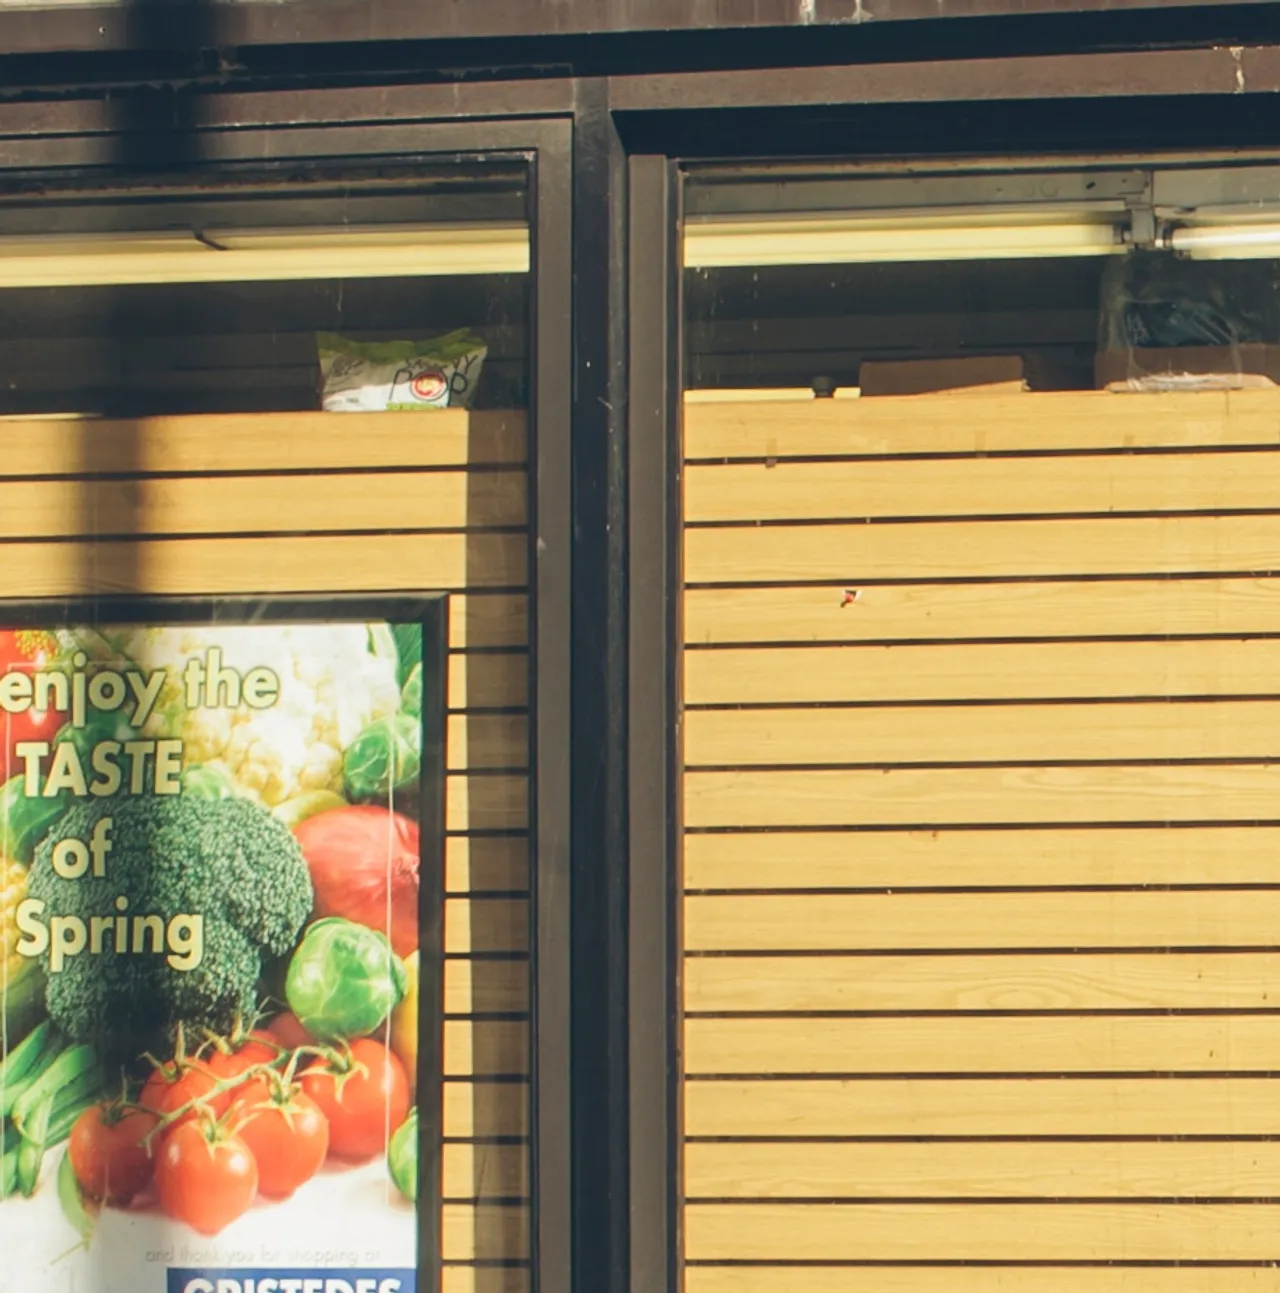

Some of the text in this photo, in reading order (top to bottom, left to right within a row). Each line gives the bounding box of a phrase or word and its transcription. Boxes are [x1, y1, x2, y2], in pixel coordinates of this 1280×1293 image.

[0, 647, 279, 727] enjoy the
[15, 740, 184, 797] TASTE
[52, 818, 113, 879] of
[15, 895, 204, 972] Spring
